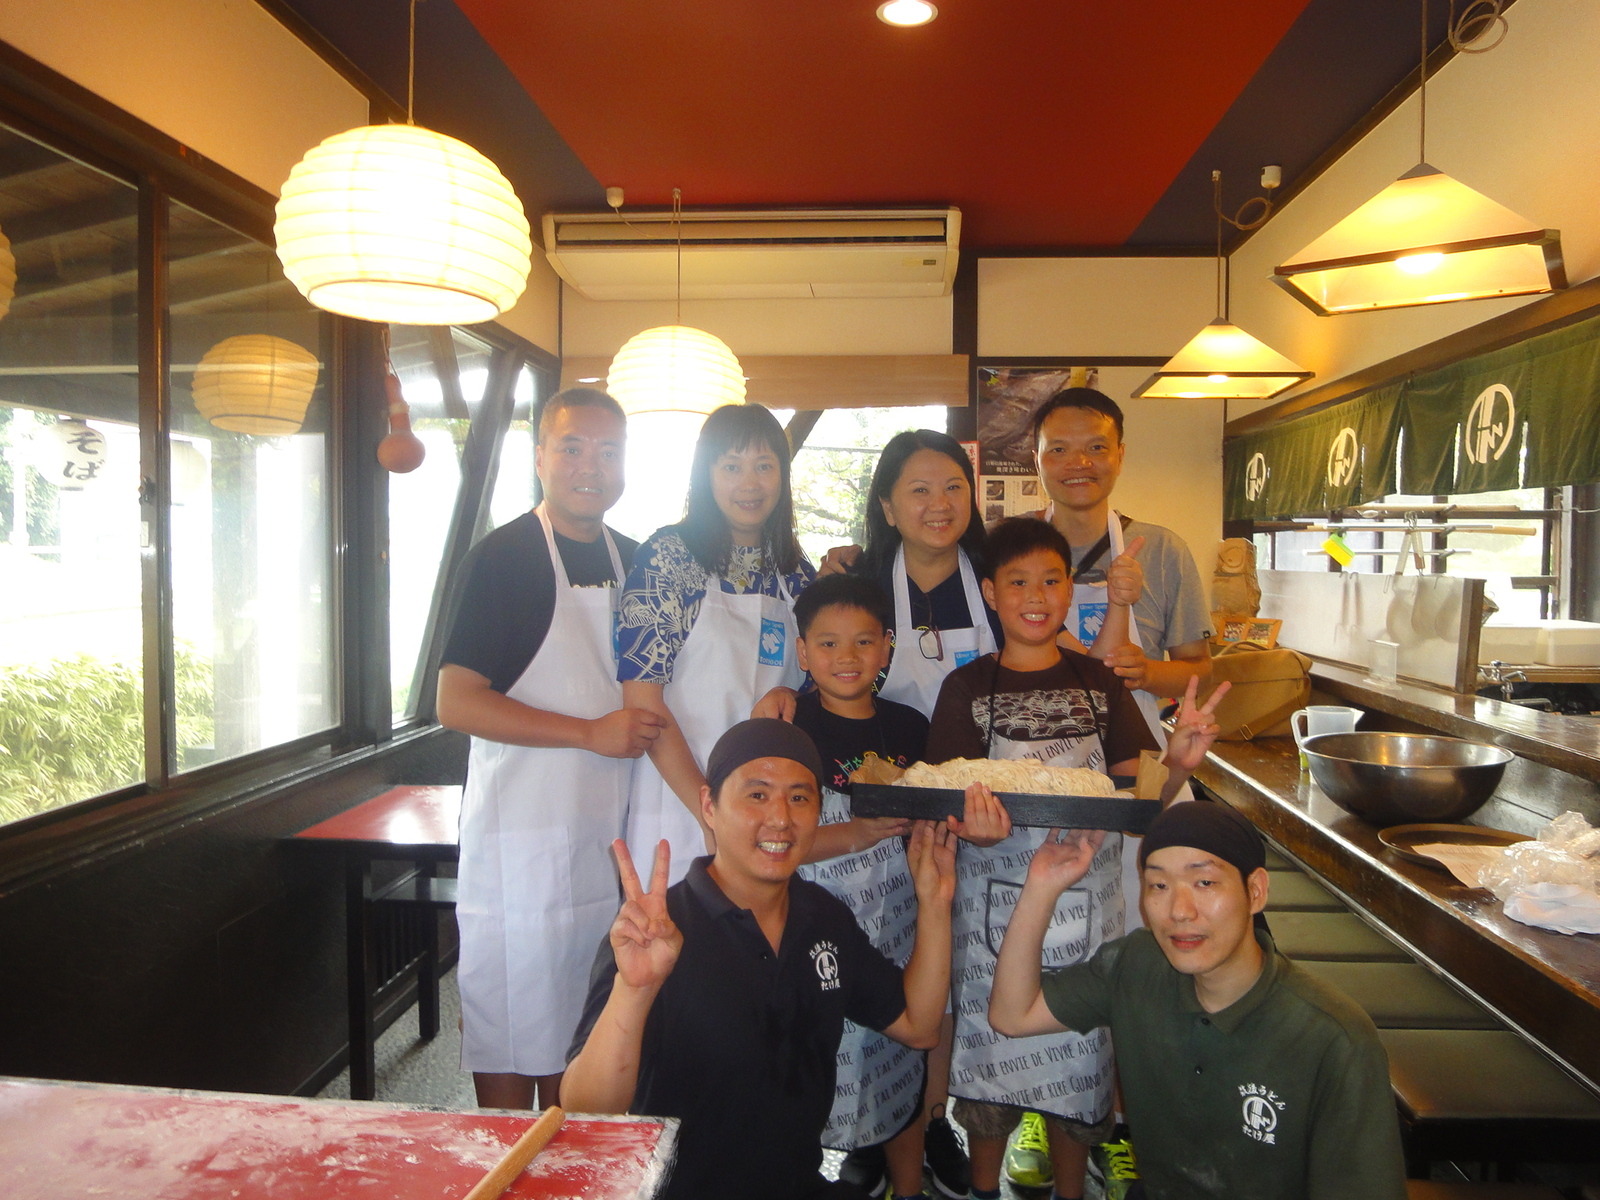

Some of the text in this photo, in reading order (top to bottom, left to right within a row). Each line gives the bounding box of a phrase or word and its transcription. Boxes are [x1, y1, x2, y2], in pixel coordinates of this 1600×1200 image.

[63, 431, 105, 480] そば
[1044, 737, 1075, 759] ENVIE
[830, 861, 858, 880] ENVIE
[861, 853, 873, 870] DE
[873, 845, 893, 864] RIRE
[969, 859, 996, 878] LISANT
[1000, 855, 1014, 870] TA
[860, 888, 874, 904] EN
[877, 872, 908, 897] LISANT
[1001, 890, 1017, 906] RIS
[893, 904, 904, 919] DE
[1053, 905, 1088, 926] LA VIE
[1043, 945, 1064, 964] J'AI
[959, 1000, 983, 1017] MAIS
[861, 1038, 886, 1060] TOUTE
[957, 1032, 986, 1050] TOUTE
[987, 1030, 1000, 1045] LA
[958, 1069, 975, 1084] RIS
[977, 1063, 998, 1081] J'AI
[1000, 1057, 1030, 1076] ENVIE
[1031, 1051, 1045, 1067] DE
[1043, 1043, 1075, 1064] VIVRE
[1077, 1037, 1099, 1056] AVEC
[836, 1083, 858, 1099] AVEC
[874, 1061, 892, 1079] J'AI
[1033, 1084, 1047, 1100] DE
[1048, 1078, 1071, 1098] RIRE
[837, 1112, 858, 1127] AVEC
[873, 1089, 890, 1109] J'AI
[891, 1072, 914, 1095] ENVIE
[913, 1061, 922, 1077] DE
[873, 1121, 886, 1138] RIS
[892, 1103, 912, 1123] MAIS
